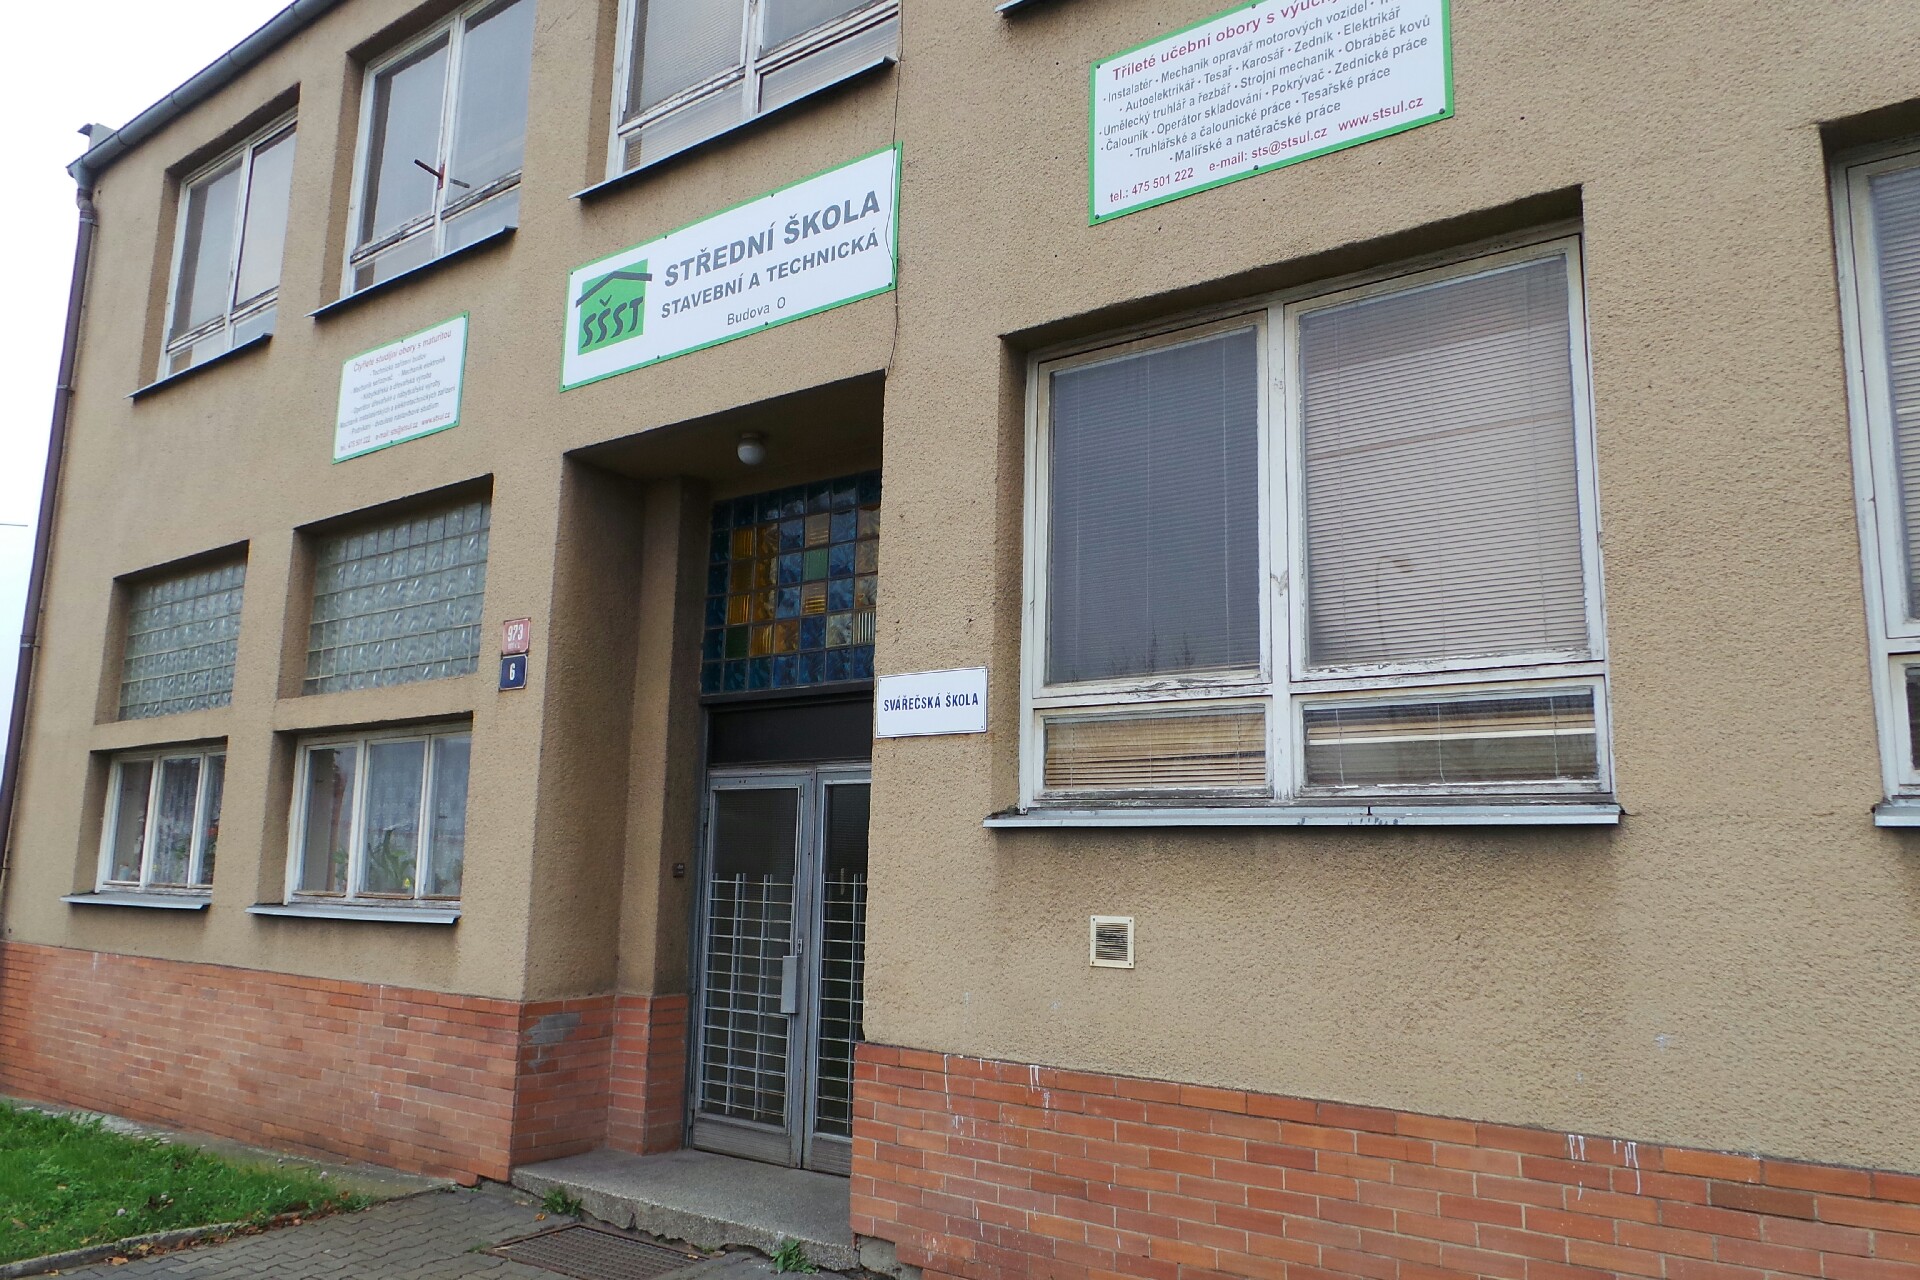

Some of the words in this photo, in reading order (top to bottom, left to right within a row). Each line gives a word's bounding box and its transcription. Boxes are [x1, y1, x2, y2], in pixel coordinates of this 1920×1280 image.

[1103, 110, 1151, 136] Umělecký
[1153, 98, 1186, 119] truhlář
[1189, 97, 1196, 107] a
[1198, 83, 1231, 104] řezbář
[1240, 67, 1277, 91] Strojní
[1279, 48, 1335, 76] mechanik
[1345, 27, 1396, 53] Obráběč
[1400, 14, 1430, 35] kovů
[1108, 78, 1153, 103] Instalatér
[1161, 58, 1209, 83] Mechanik
[1212, 41, 1253, 65] opravář
[1256, 17, 1323, 50] motorových
[1326, 0, 1367, 24] vozidel
[1112, 54, 1156, 81] Tříleté
[1161, 33, 1212, 63] učební
[1216, 18, 1261, 42] obory
[1266, 12, 1276, 24] s
[1125, 78, 1195, 112] Autoelektrikář
[1204, 63, 1233, 85] Tesař
[1242, 47, 1285, 71] Karosář
[1343, 6, 1401, 36] Elektrikář
[1106, 129, 1149, 152] Čalouník
[1157, 112, 1202, 135] Operátor
[1204, 89, 1263, 119] skladování
[1271, 68, 1325, 96] Pokrývač
[1334, 46, 1389, 75] Zednické
[1392, 36, 1428, 59] práce
[1135, 131, 1188, 159] Truhlářské
[1190, 131, 1197, 141] a
[1200, 109, 1257, 137] čalounické
[1260, 99, 1291, 121] práce
[1302, 76, 1354, 104] Tesařské
[1357, 66, 1391, 88] práce
[1175, 136, 1223, 163] Malířské
[1226, 136, 1233, 147] a
[1236, 111, 1302, 144] natěračské
[1305, 101, 1341, 123] práce
[1110, 187, 1129, 203] tel.:
[1131, 180, 1150, 195] 475
[1153, 173, 1171, 189] 501
[1174, 167, 1194, 183] 222
[1209, 151, 1248, 172] e-mail:
[1251, 127, 1328, 160] sts@stsul.cz
[1338, 97, 1424, 131] www.stsul.cz
[661, 272, 745, 319] STAVEBNÍ
[748, 272, 761, 291] A
[767, 227, 879, 283] TECHNICKÁ
[664, 221, 777, 287] STŘEDNÍ
[783, 190, 880, 245] ŠKOLA
[727, 303, 770, 326] Budova
[507, 624, 524, 642] 973
[509, 662, 516, 681] 6
[883, 693, 941, 712] SVÁŘEČSKÁ
[945, 692, 979, 708] ŠKOLA
